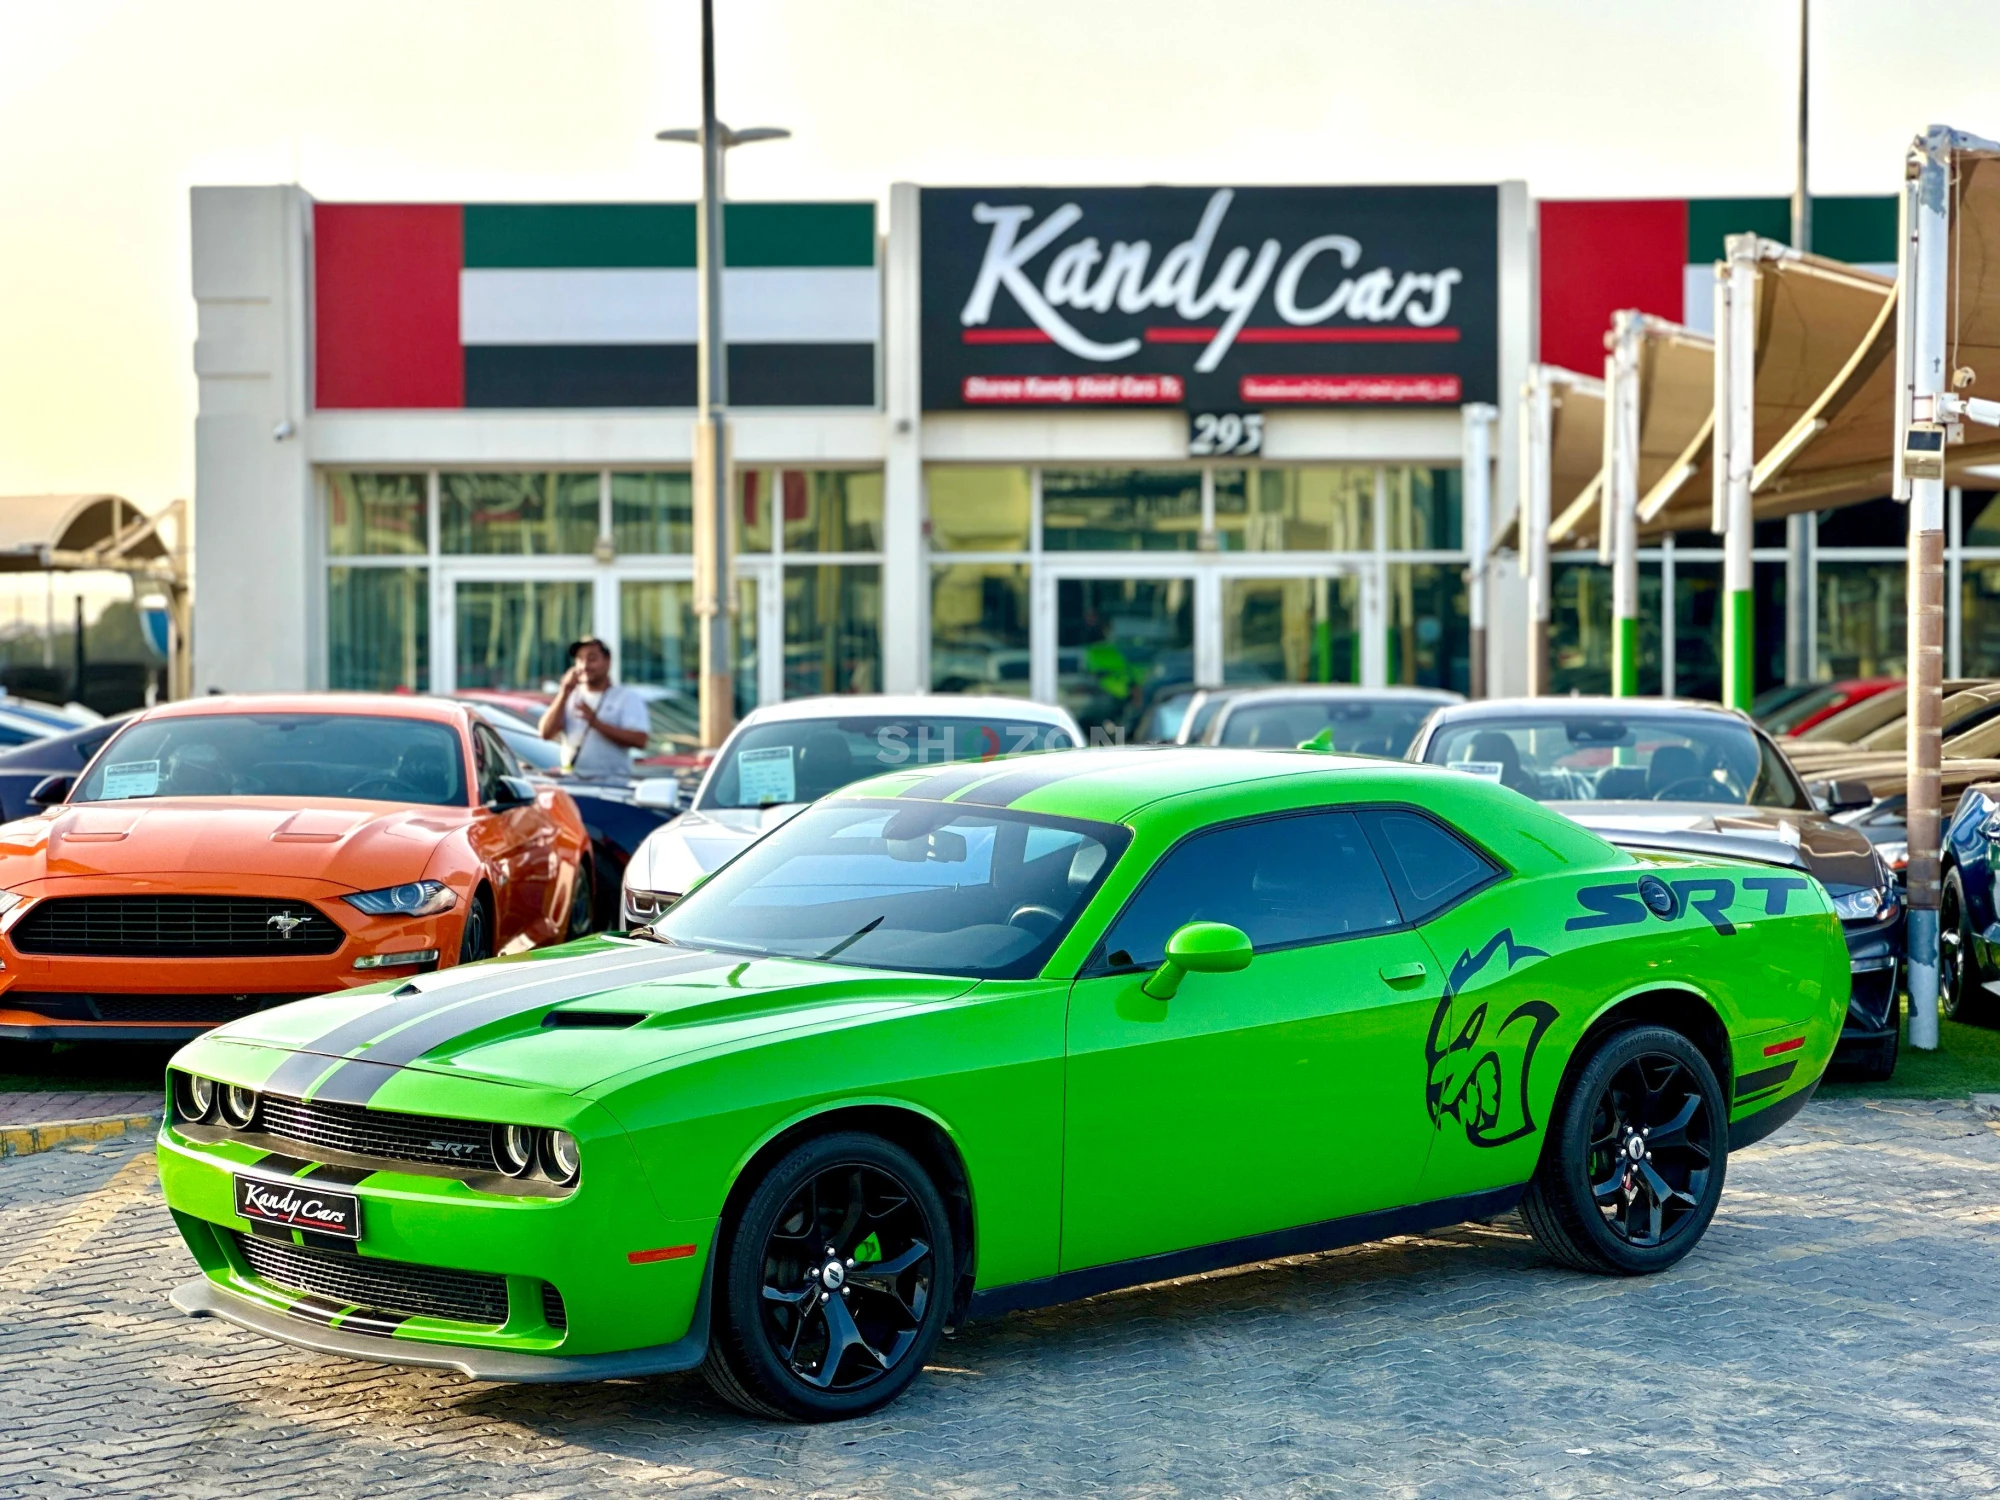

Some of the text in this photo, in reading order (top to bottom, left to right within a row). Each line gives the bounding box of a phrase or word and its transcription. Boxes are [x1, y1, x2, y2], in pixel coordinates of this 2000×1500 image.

[961, 188, 1462, 372] Kandy Cars
[1190, 413, 1264, 455] 295
[1565, 878, 1808, 936] SRT
[427, 1141, 480, 1157] SRT
[244, 1182, 346, 1223] Kandy Cars
